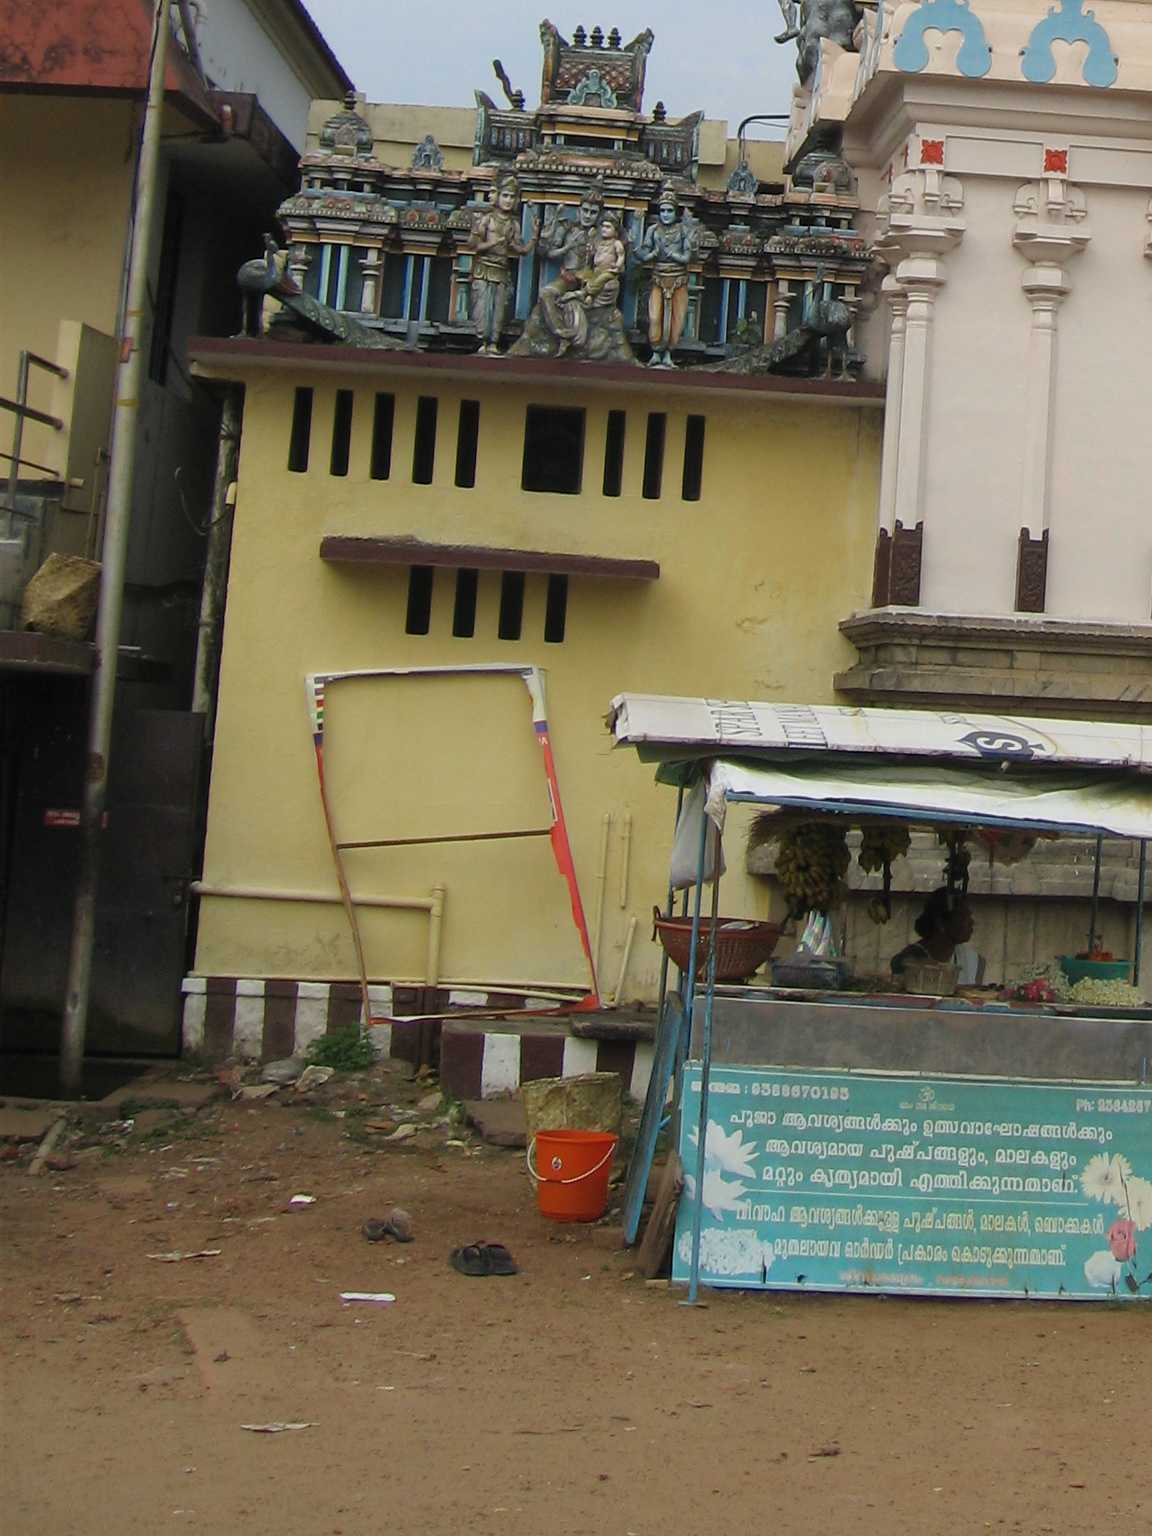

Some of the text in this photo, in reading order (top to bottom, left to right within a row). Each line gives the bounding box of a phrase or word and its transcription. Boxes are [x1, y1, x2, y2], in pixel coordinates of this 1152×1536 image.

[766, 1139, 864, 1159] ആവശ്യമായ
[995, 1147, 1078, 1171] മാലകളും
[762, 1166, 804, 1187] മറ്റും
[809, 1167, 903, 1190] കൃത്യമായി
